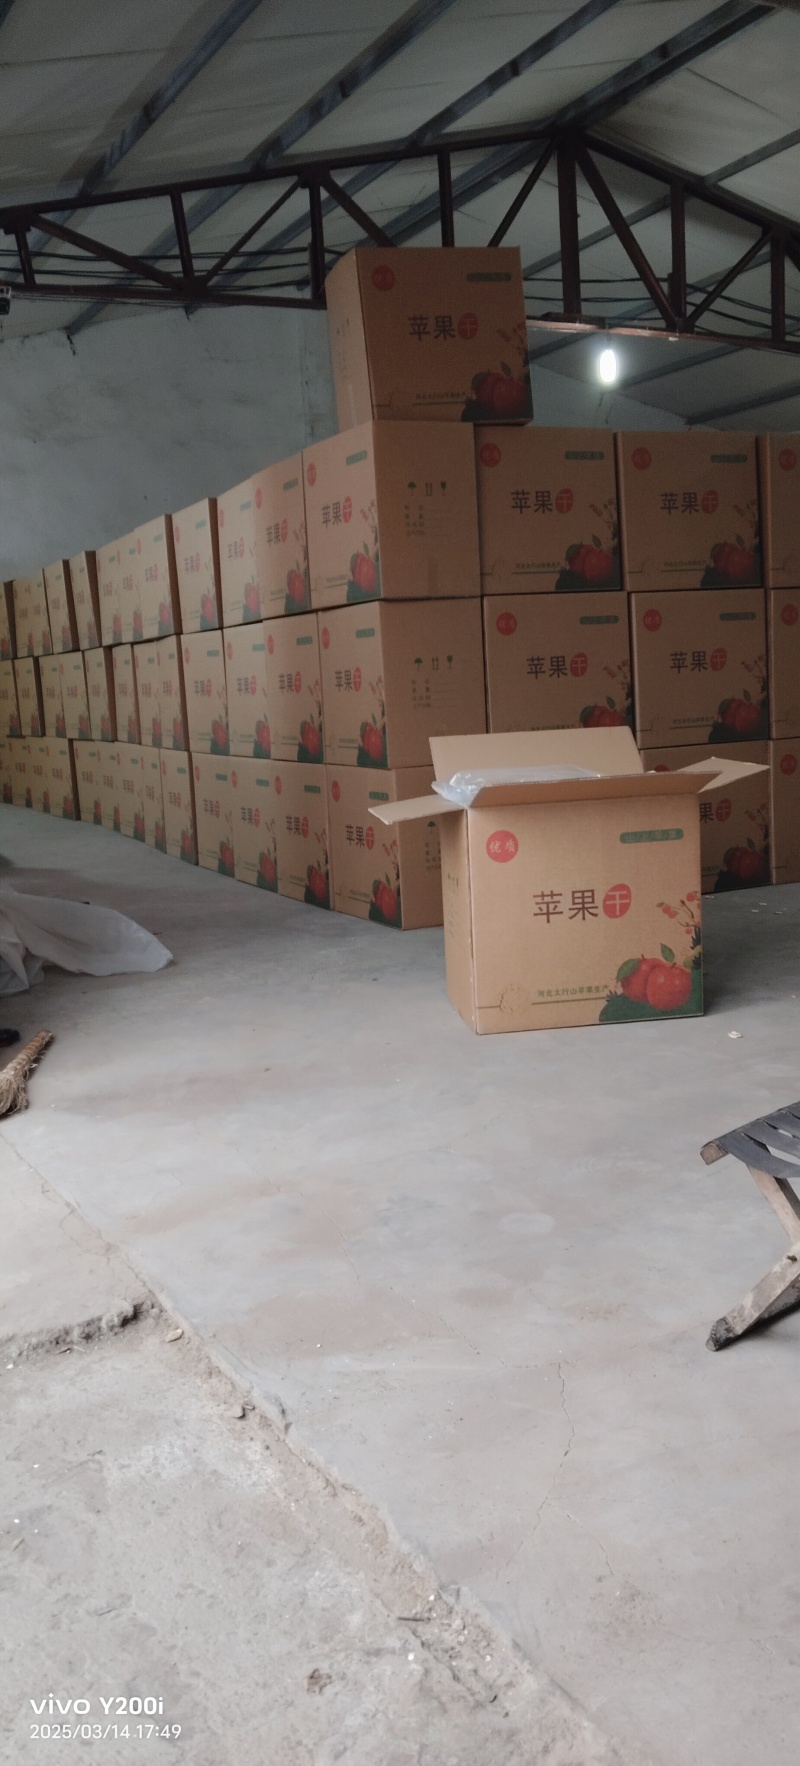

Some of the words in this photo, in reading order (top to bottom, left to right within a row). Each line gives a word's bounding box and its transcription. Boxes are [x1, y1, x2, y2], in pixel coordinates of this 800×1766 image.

[407, 313, 477, 342] 苹果干
[321, 497, 352, 529] 苹果干
[510, 488, 573, 515] 苹果干
[659, 490, 718, 516] 苹果干
[526, 654, 588, 680] 苹果干
[670, 650, 727, 674] 苹果干
[489, 839, 516, 854] 优质
[532, 887, 631, 924] 苹果干
